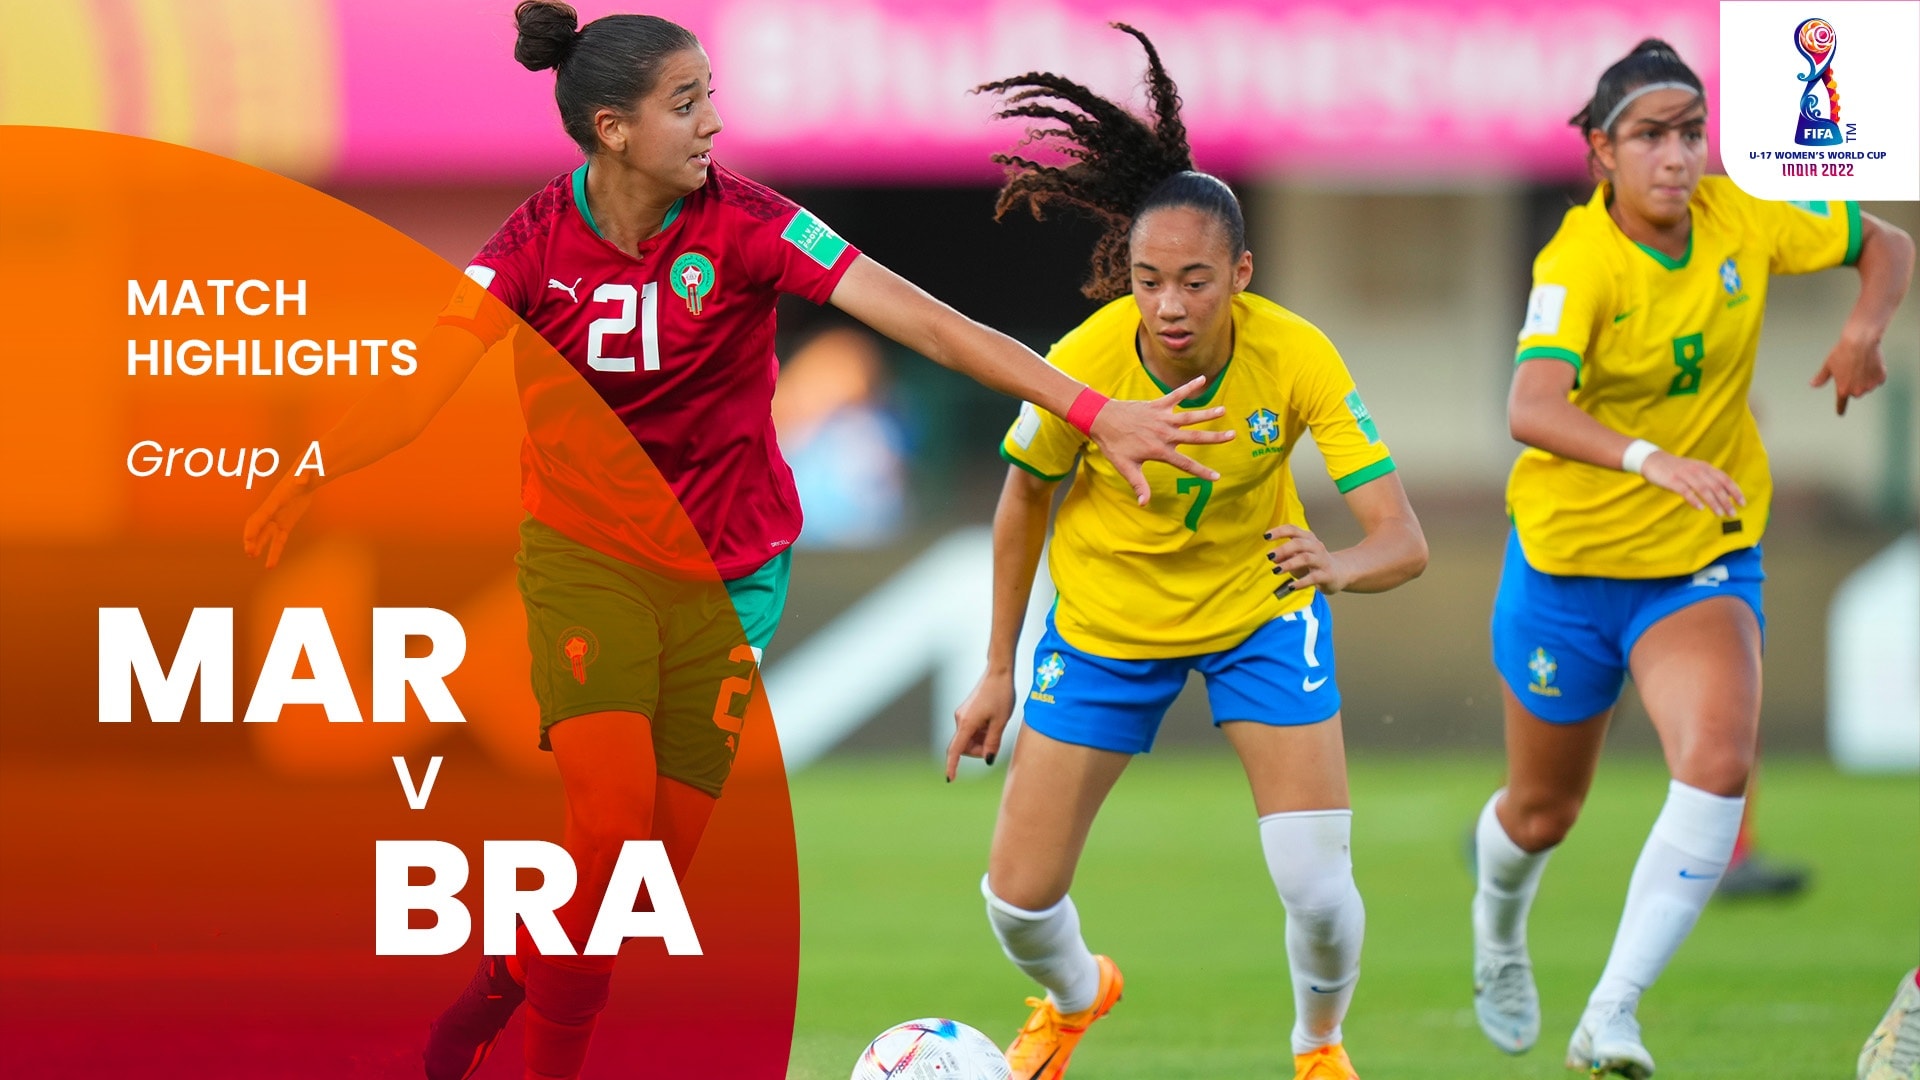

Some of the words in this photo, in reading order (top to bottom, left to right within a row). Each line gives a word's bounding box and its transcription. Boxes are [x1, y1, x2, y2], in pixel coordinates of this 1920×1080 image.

[587, 281, 661, 372] 21
[1667, 332, 1705, 397] 8
[1176, 477, 1213, 532] 7
